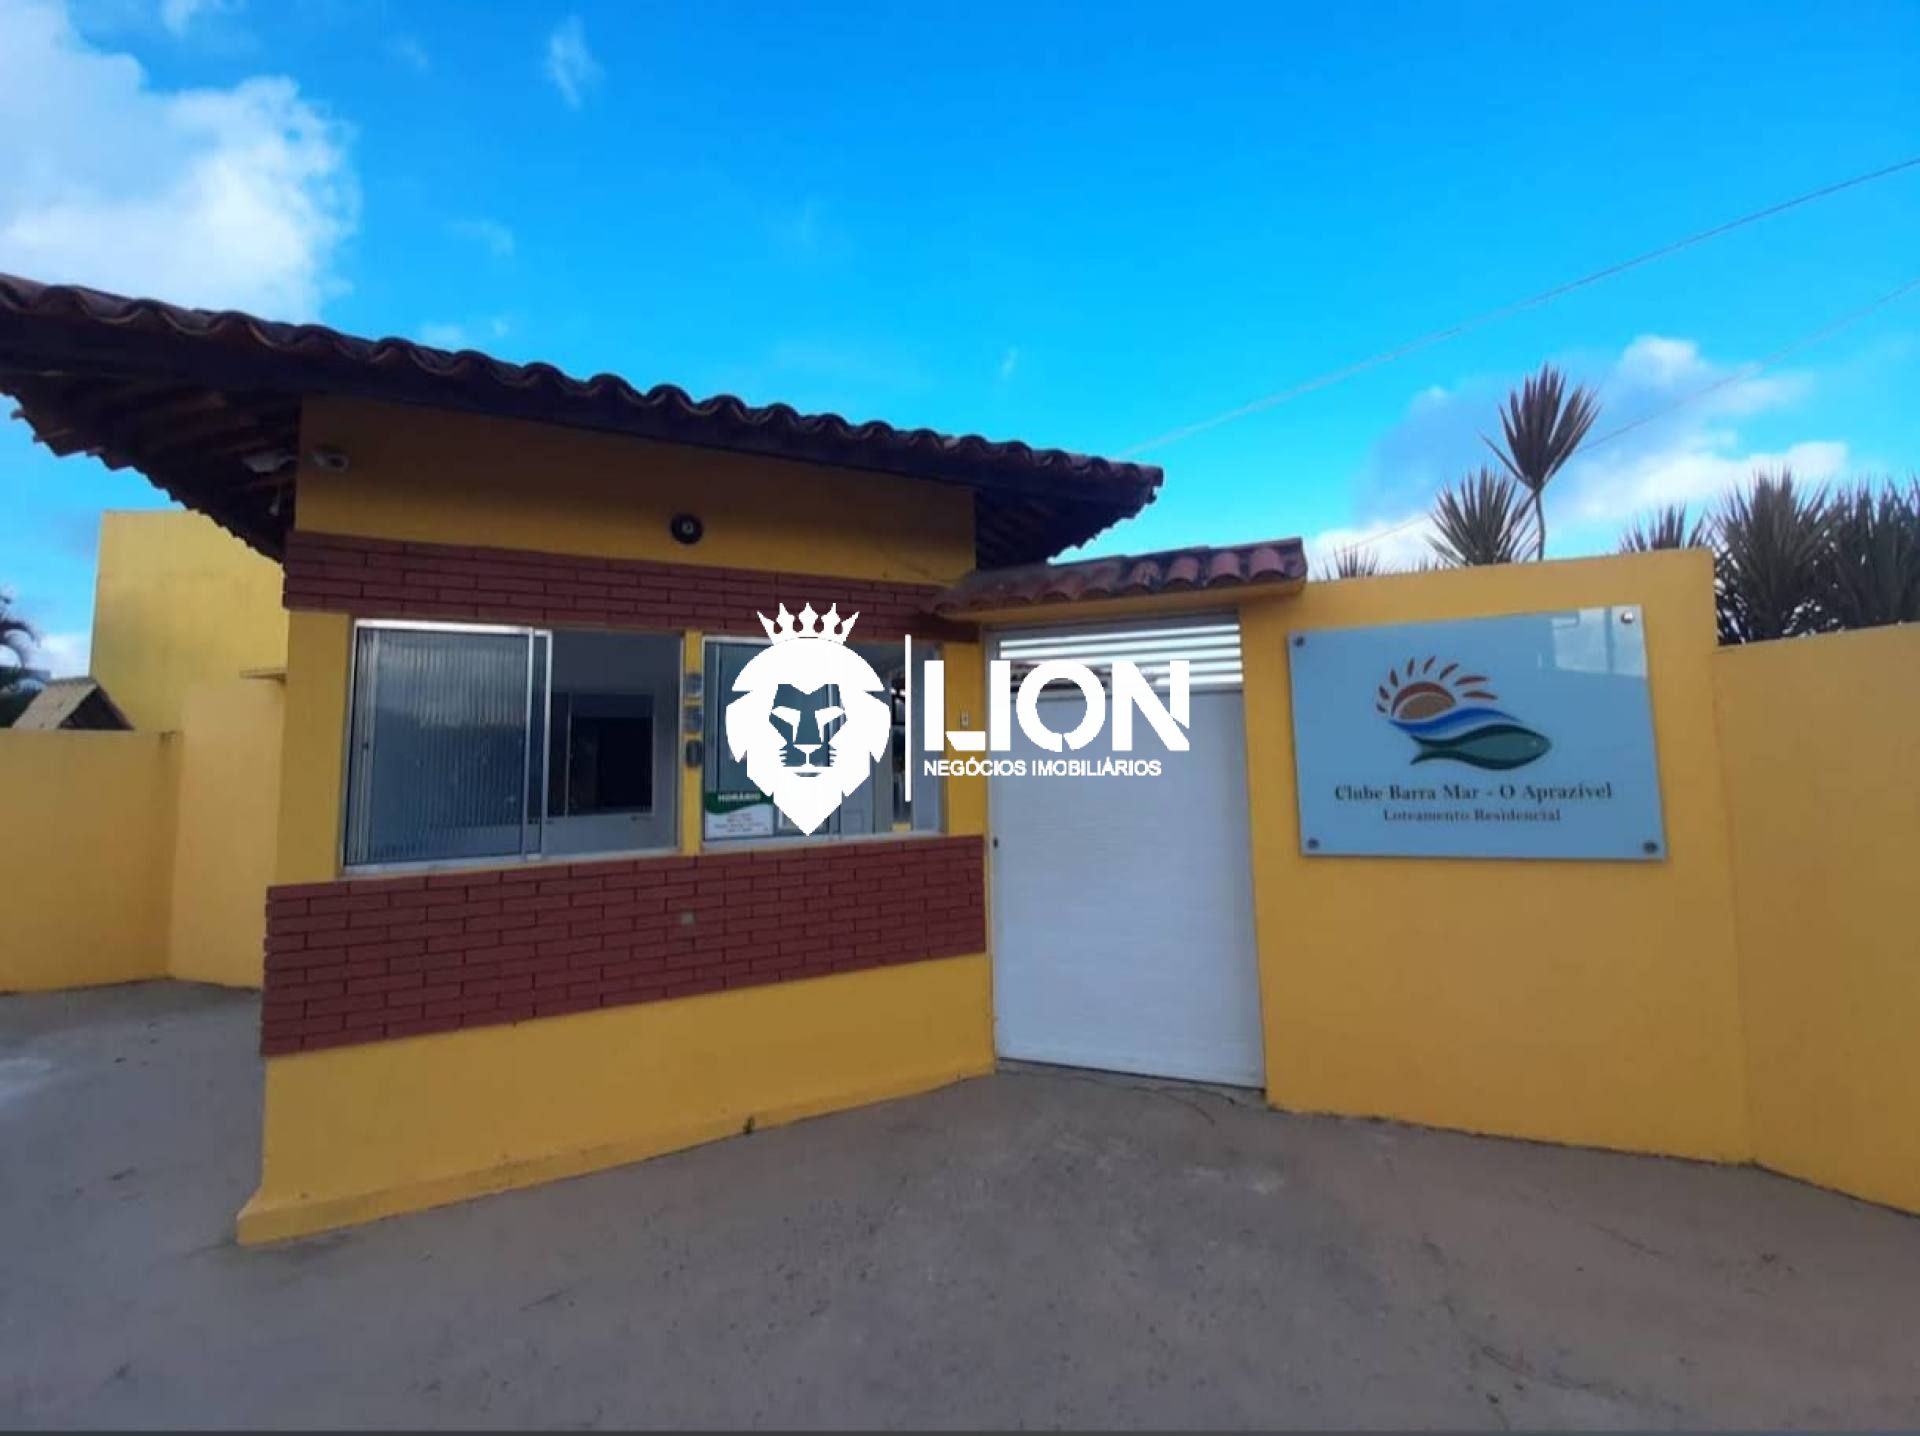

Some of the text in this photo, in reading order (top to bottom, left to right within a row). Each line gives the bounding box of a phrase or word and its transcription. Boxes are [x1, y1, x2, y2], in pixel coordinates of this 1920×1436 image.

[1335, 784, 1382, 801] Clube
[1389, 784, 1436, 801] Barra
[1443, 784, 1478, 801] Mar
[1499, 784, 1515, 800] O
[1522, 782, 1612, 804] Aprazível
[1383, 807, 1561, 822] Loteamento Residencial
